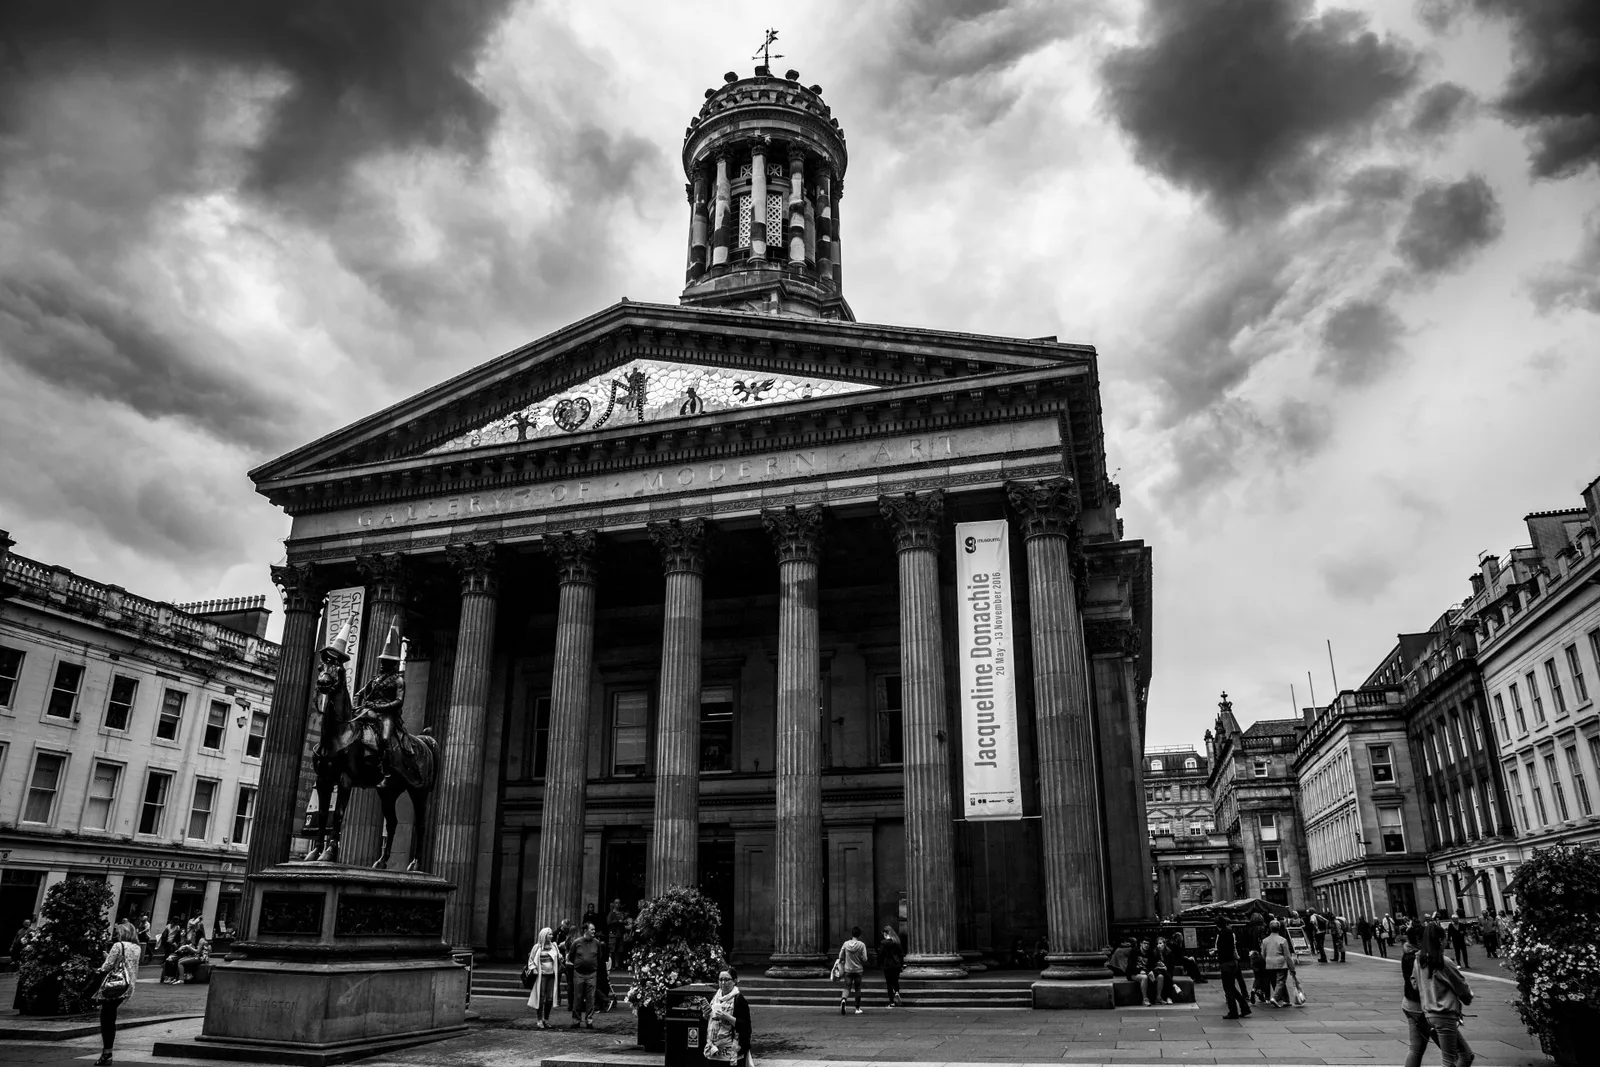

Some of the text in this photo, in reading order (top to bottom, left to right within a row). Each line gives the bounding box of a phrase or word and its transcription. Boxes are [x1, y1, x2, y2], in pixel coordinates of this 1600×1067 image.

[358, 435, 956, 527] GALLERY OF MODERN ART
[992, 572, 1001, 589] 2016
[330, 594, 341, 645] NATION
[340, 593, 351, 630] INTE
[967, 573, 992, 658] Donachie
[993, 591, 1003, 630] November
[995, 632, 1003, 640] 13
[996, 648, 1006, 664] May
[996, 666, 1005, 676] 20
[971, 664, 1000, 768] Jacqueline
[100, 856, 138, 866] PAULINE
[140, 859, 168, 868] BOOKS
[178, 862, 203, 870] MEDIA
